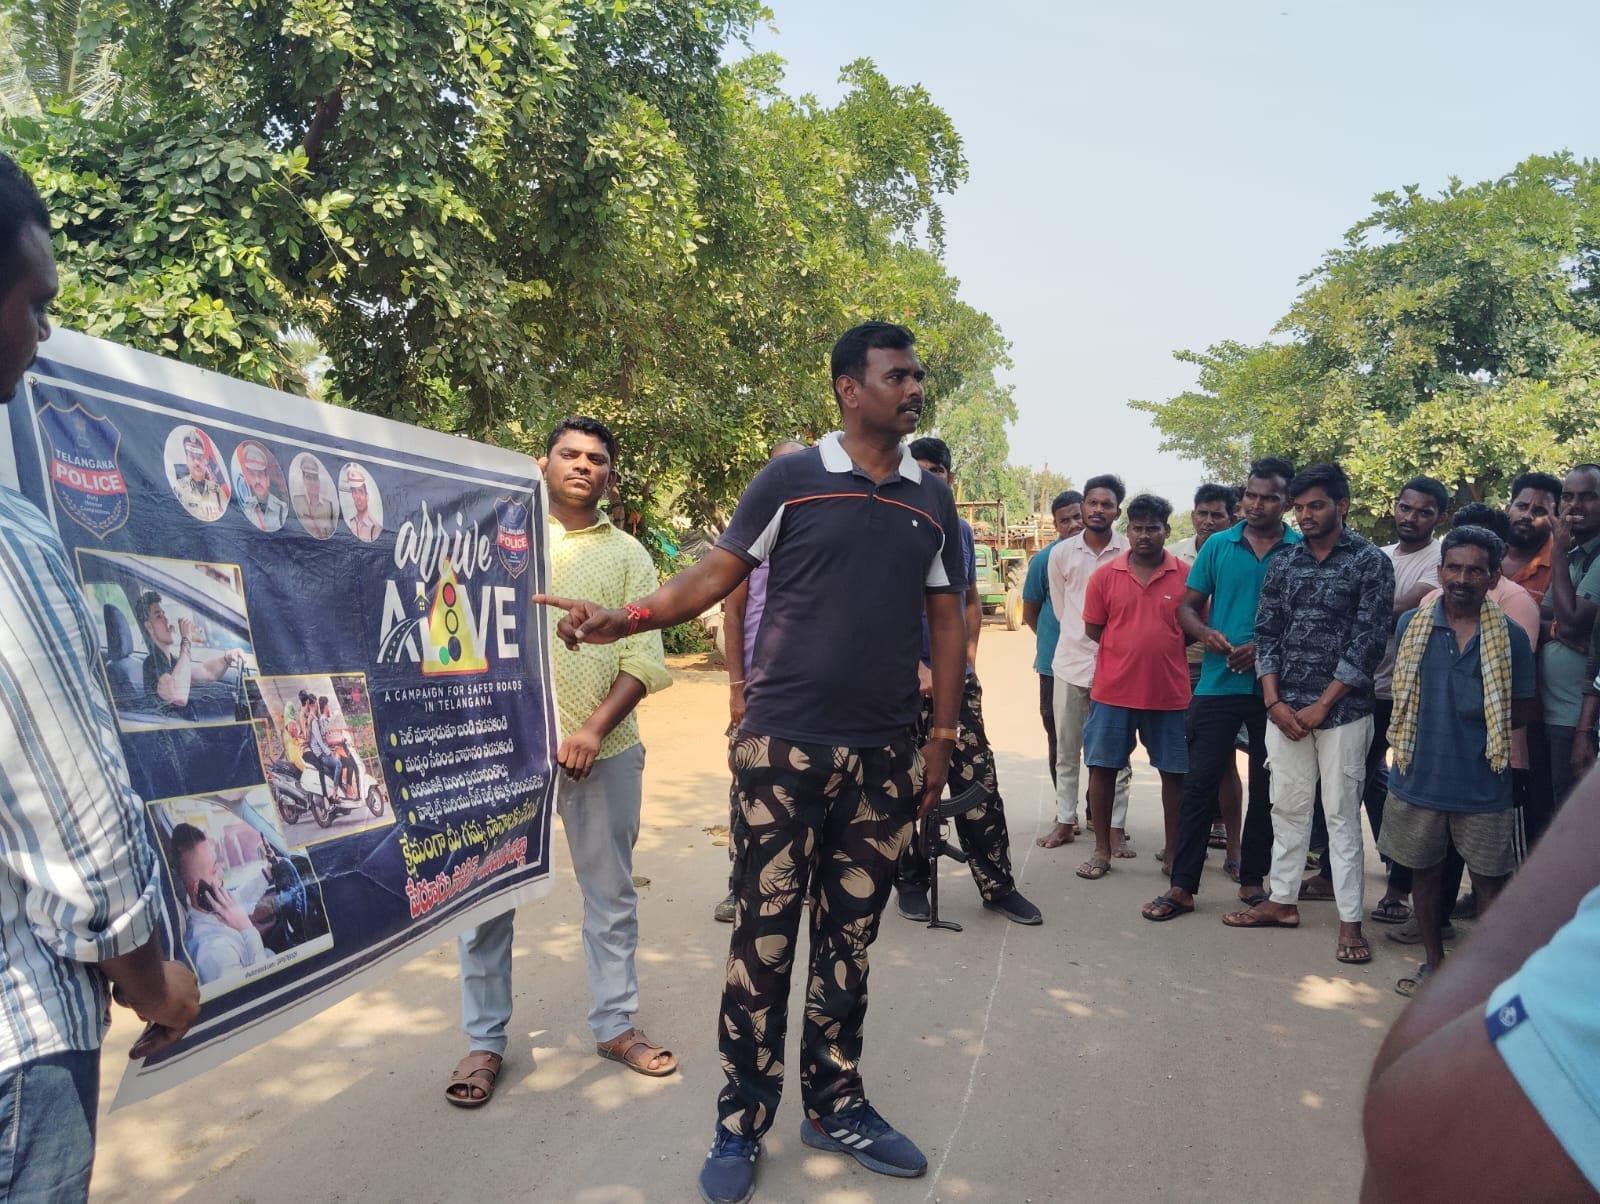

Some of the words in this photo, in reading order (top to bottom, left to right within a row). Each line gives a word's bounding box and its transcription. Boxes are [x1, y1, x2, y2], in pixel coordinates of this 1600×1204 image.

[55, 448, 115, 470] TELANGANA
[55, 462, 122, 491] POLICE
[394, 499, 492, 584] arrive
[499, 525, 525, 536] TELANGANA
[499, 534, 528, 549] POLICE
[384, 689, 391, 702] A
[395, 684, 444, 702] CAMPAIGN
[447, 683, 465, 697] FOR
[467, 681, 494, 695] SAFER
[496, 679, 522, 692] ROADS
[424, 701, 434, 713] IN
[438, 695, 493, 712] TELANGANA
[399, 725, 414, 746] సెల్
[414, 723, 457, 748] మాట్లాడుతూ
[457, 718, 475, 738] బండి
[405, 755, 429, 777] మద్యం
[429, 749, 454, 768] సేవించి
[455, 744, 482, 763] వాహనం
[444, 773, 465, 791] మించి
[442, 795, 469, 815] మరియు
[400, 832, 446, 877] క్షేమంగా
[447, 822, 462, 851] మీ
